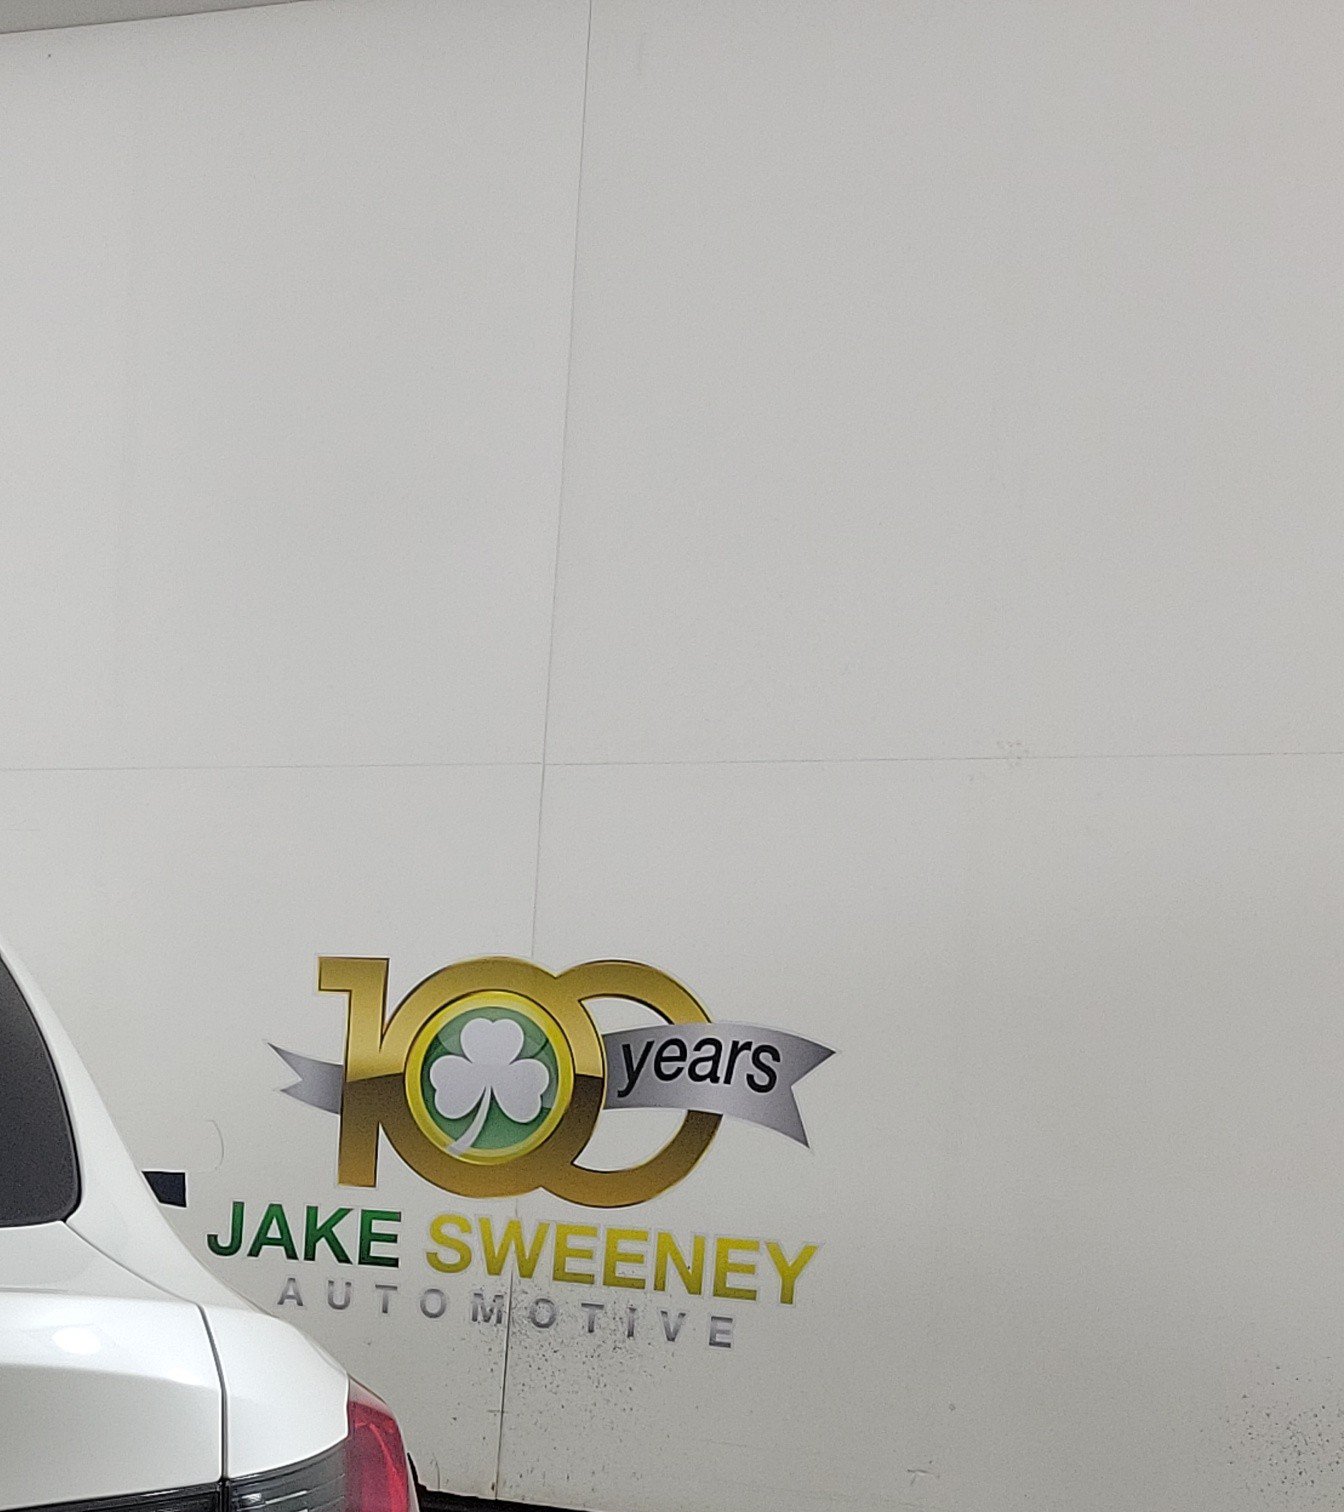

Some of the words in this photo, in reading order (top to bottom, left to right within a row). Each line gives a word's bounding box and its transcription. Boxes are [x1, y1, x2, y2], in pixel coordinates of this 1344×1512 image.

[317, 955, 724, 1208] 100
[615, 1036, 782, 1098] years
[206, 1199, 402, 1268] JAKE
[425, 1214, 820, 1305] SWEENEY
[277, 1276, 736, 1349] AUTOMOTIVE
